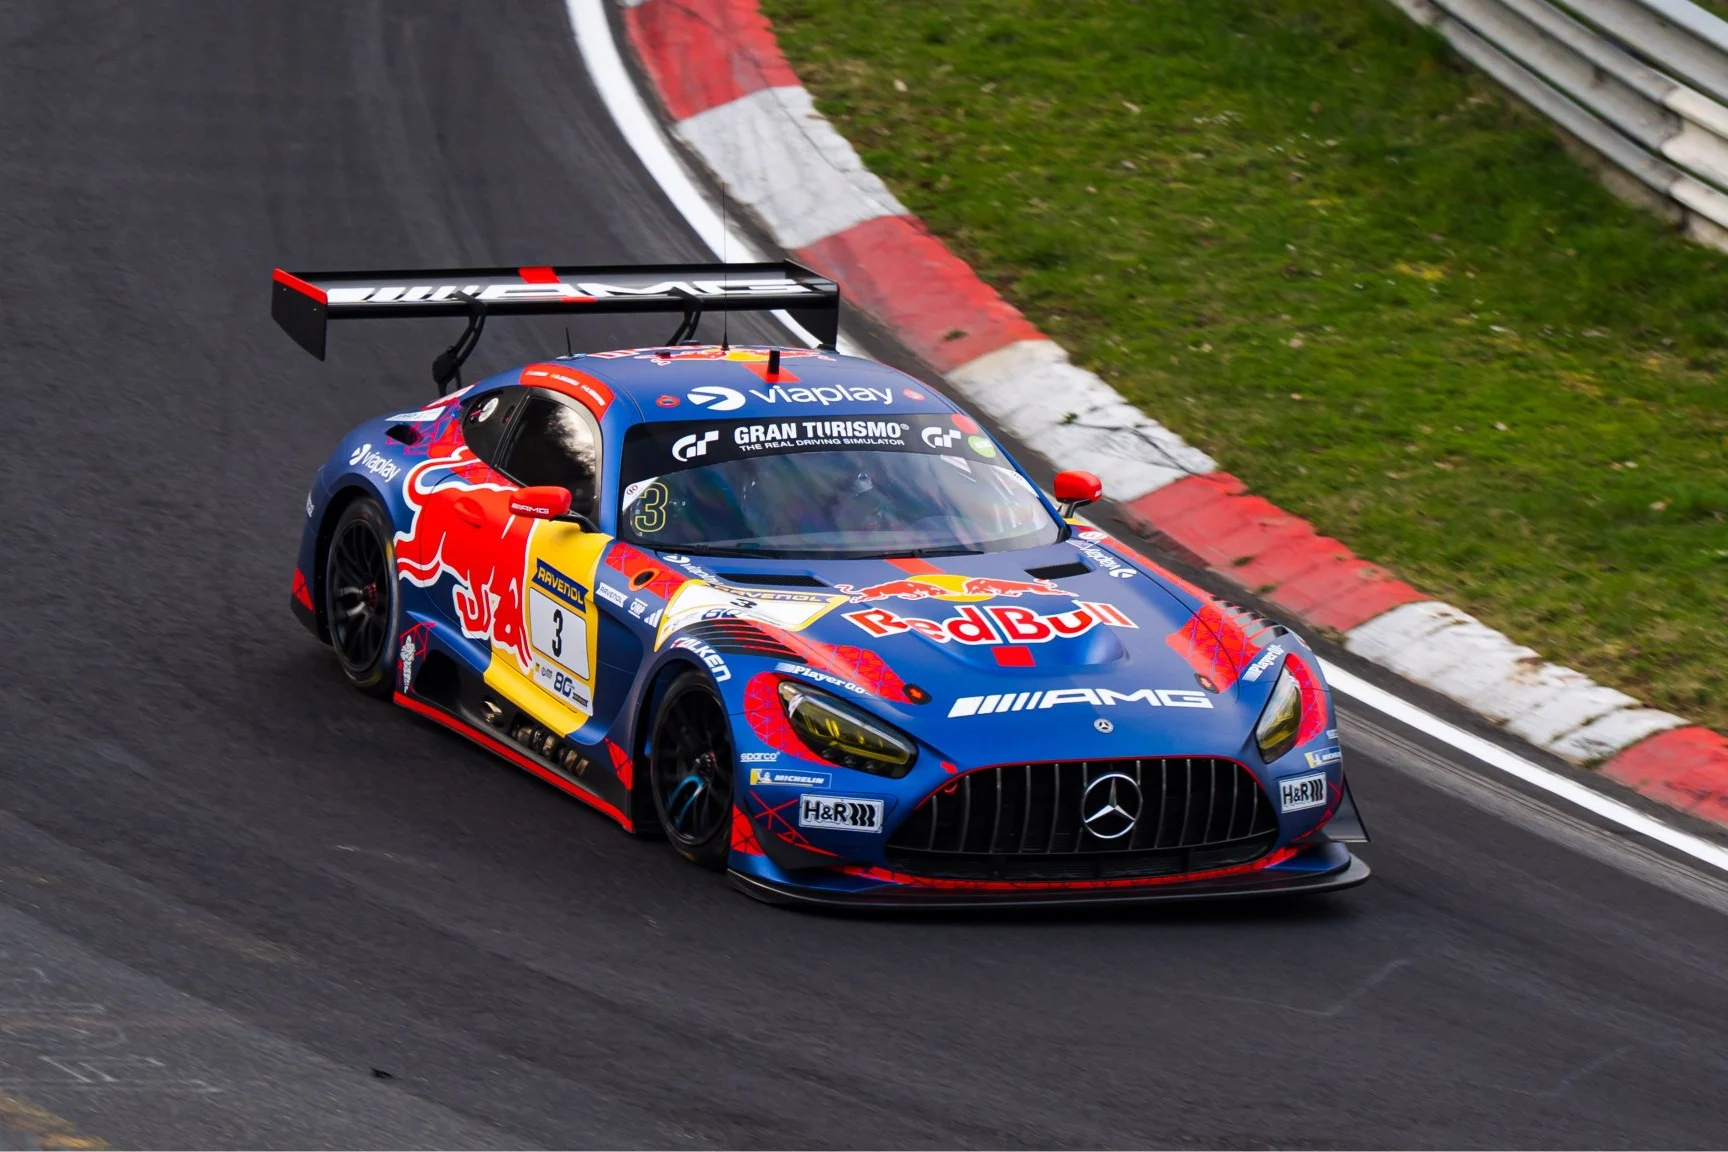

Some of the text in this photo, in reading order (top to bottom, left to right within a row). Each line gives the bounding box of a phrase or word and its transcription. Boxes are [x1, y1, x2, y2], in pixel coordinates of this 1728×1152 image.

[749, 385, 894, 406] viaplay
[734, 421, 901, 444] GRAN TURISMO
[739, 437, 905, 452] THE REAL DRIVING SIMULATOR
[361, 451, 401, 482] viaplay
[634, 481, 669, 533] 3
[537, 566, 584, 605] RAVENOL
[552, 609, 564, 658] 3
[669, 637, 732, 682] FALKEN
[1042, 688, 1214, 709] AMG
[740, 752, 777, 762] sparco
[774, 774, 825, 785] MICHELIN
[1282, 783, 1310, 805] H&R
[804, 800, 847, 823] H&R
